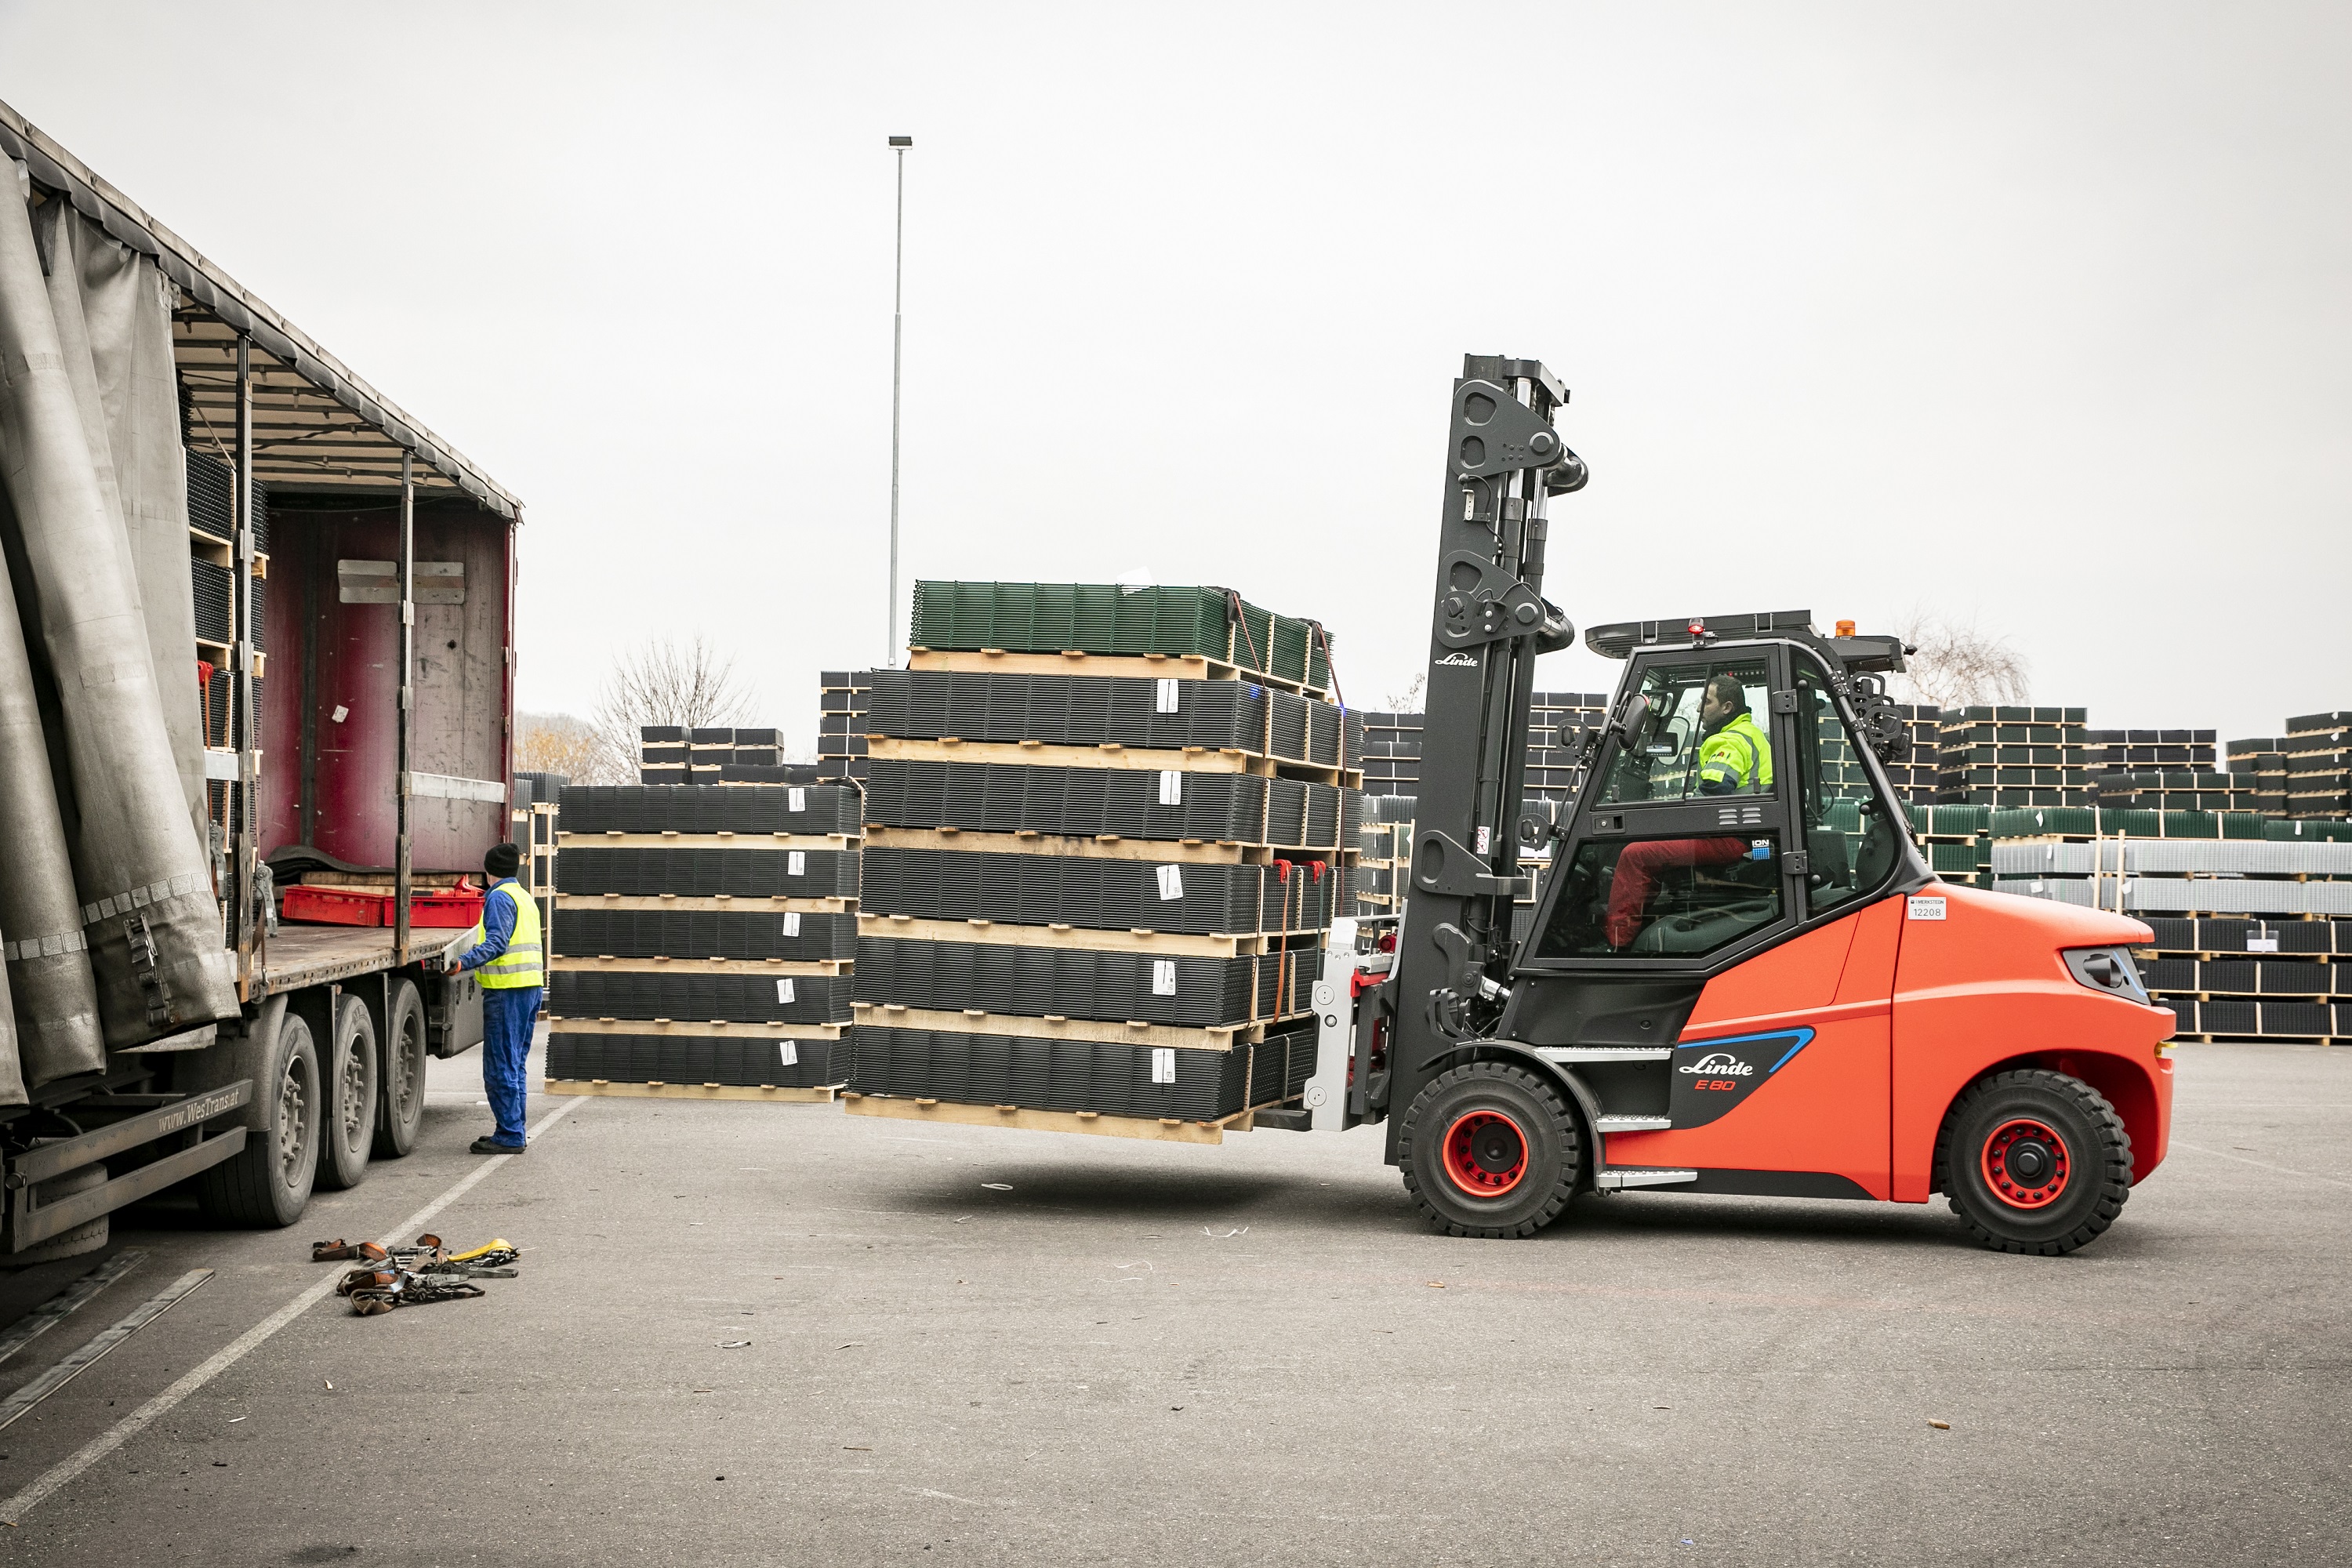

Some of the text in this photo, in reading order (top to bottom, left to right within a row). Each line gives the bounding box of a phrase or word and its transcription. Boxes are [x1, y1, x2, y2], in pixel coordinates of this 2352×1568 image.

[1435, 652, 1478, 666] Linde
[1914, 908, 1941, 916] 12208
[1679, 1053, 1753, 1076] Linde
[1694, 1080, 1736, 1091] E 80
[158, 1088, 239, 1132] www.WesTrans.at
